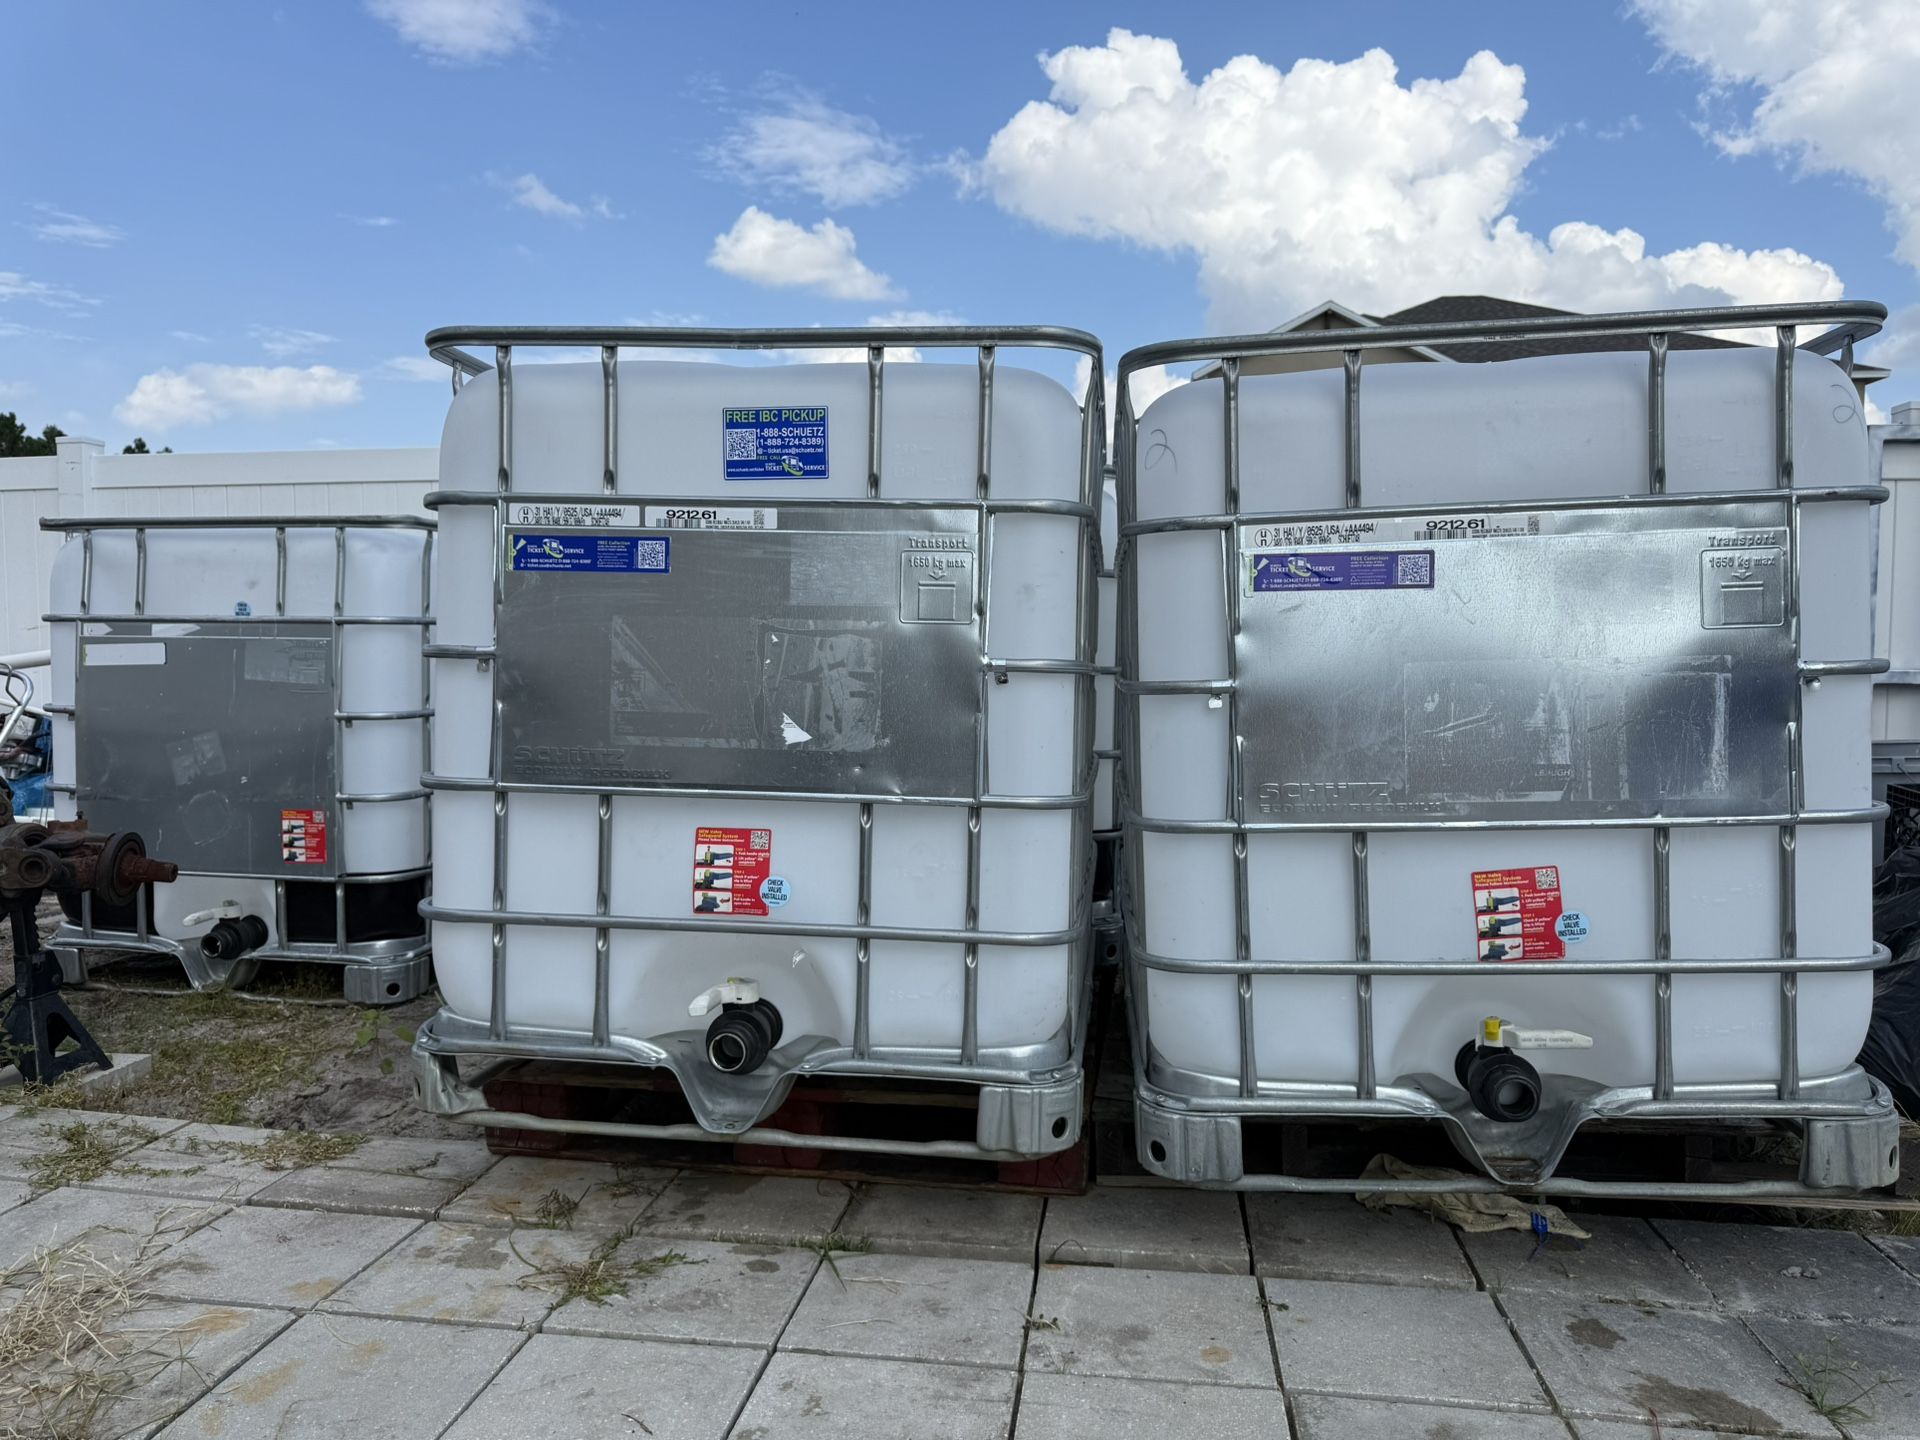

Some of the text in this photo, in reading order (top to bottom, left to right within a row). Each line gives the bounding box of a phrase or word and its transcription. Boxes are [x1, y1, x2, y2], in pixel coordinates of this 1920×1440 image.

[726, 409, 824, 423] FREE IBC PICKUP
[756, 427, 824, 437] 1-888-SCHUETZ
[756, 437, 825, 448] (1-888-724-8389)
[666, 509, 717, 520] 9212.61
[1426, 518, 1485, 531] 9212.61
[1273, 528, 1281, 538] 31
[908, 537, 968, 550] Transport
[1708, 532, 1777, 547] Transport
[908, 556, 966, 570] 1650 kg max
[1708, 555, 1776, 569] 1650 kg max
[761, 893, 788, 901] INSTALLED
[1561, 913, 1580, 921] CHECK
[1558, 928, 1587, 937] INSTALLED
